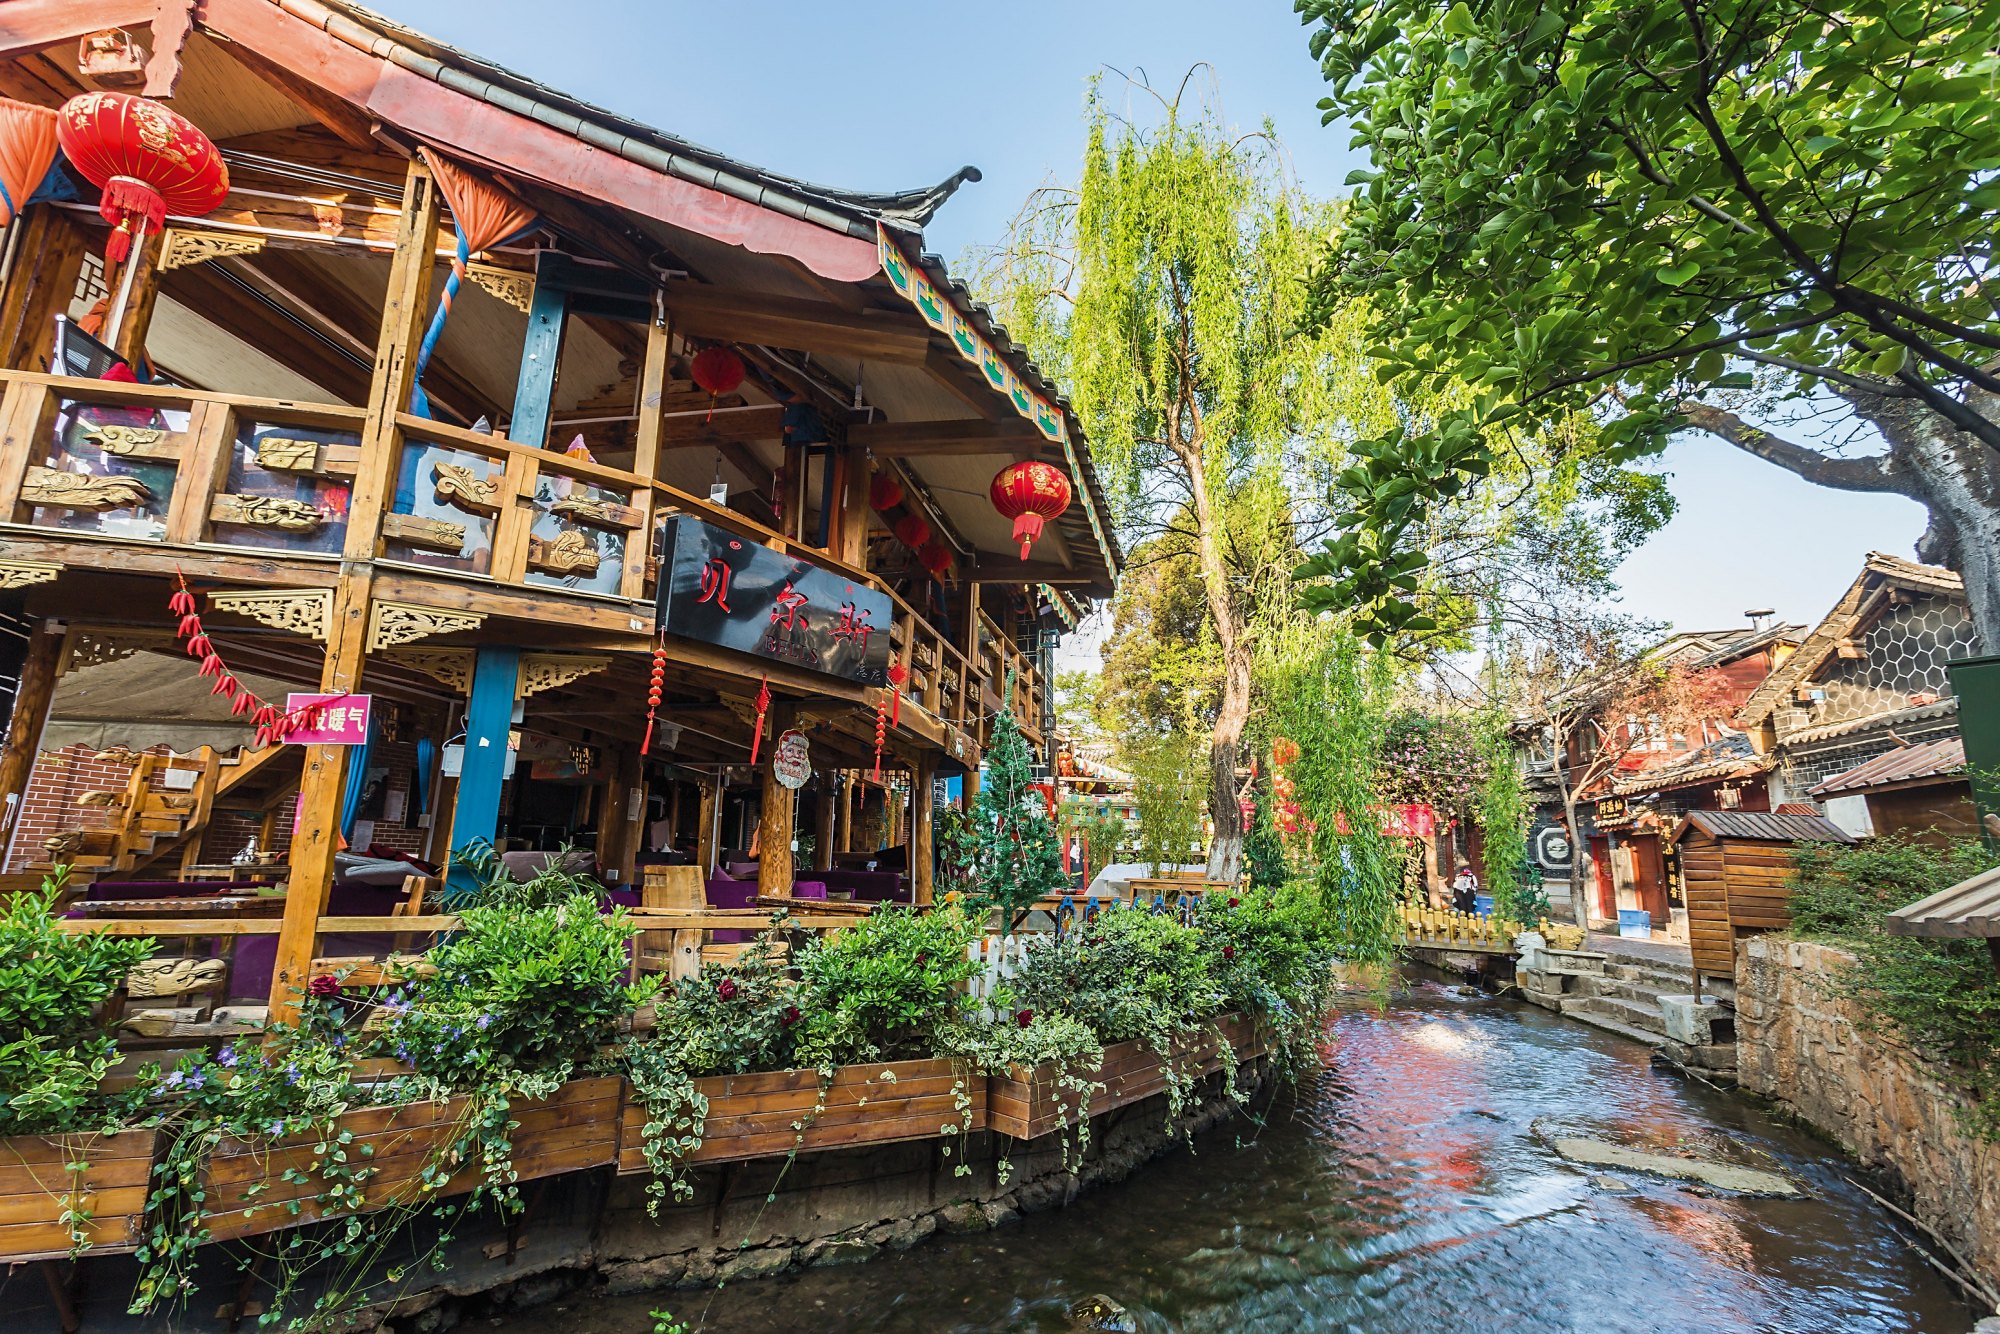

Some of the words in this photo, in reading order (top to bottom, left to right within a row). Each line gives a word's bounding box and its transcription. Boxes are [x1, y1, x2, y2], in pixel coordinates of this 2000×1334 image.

[696, 557, 876, 656] 贝尔斯
[765, 634, 818, 664] BELLS
